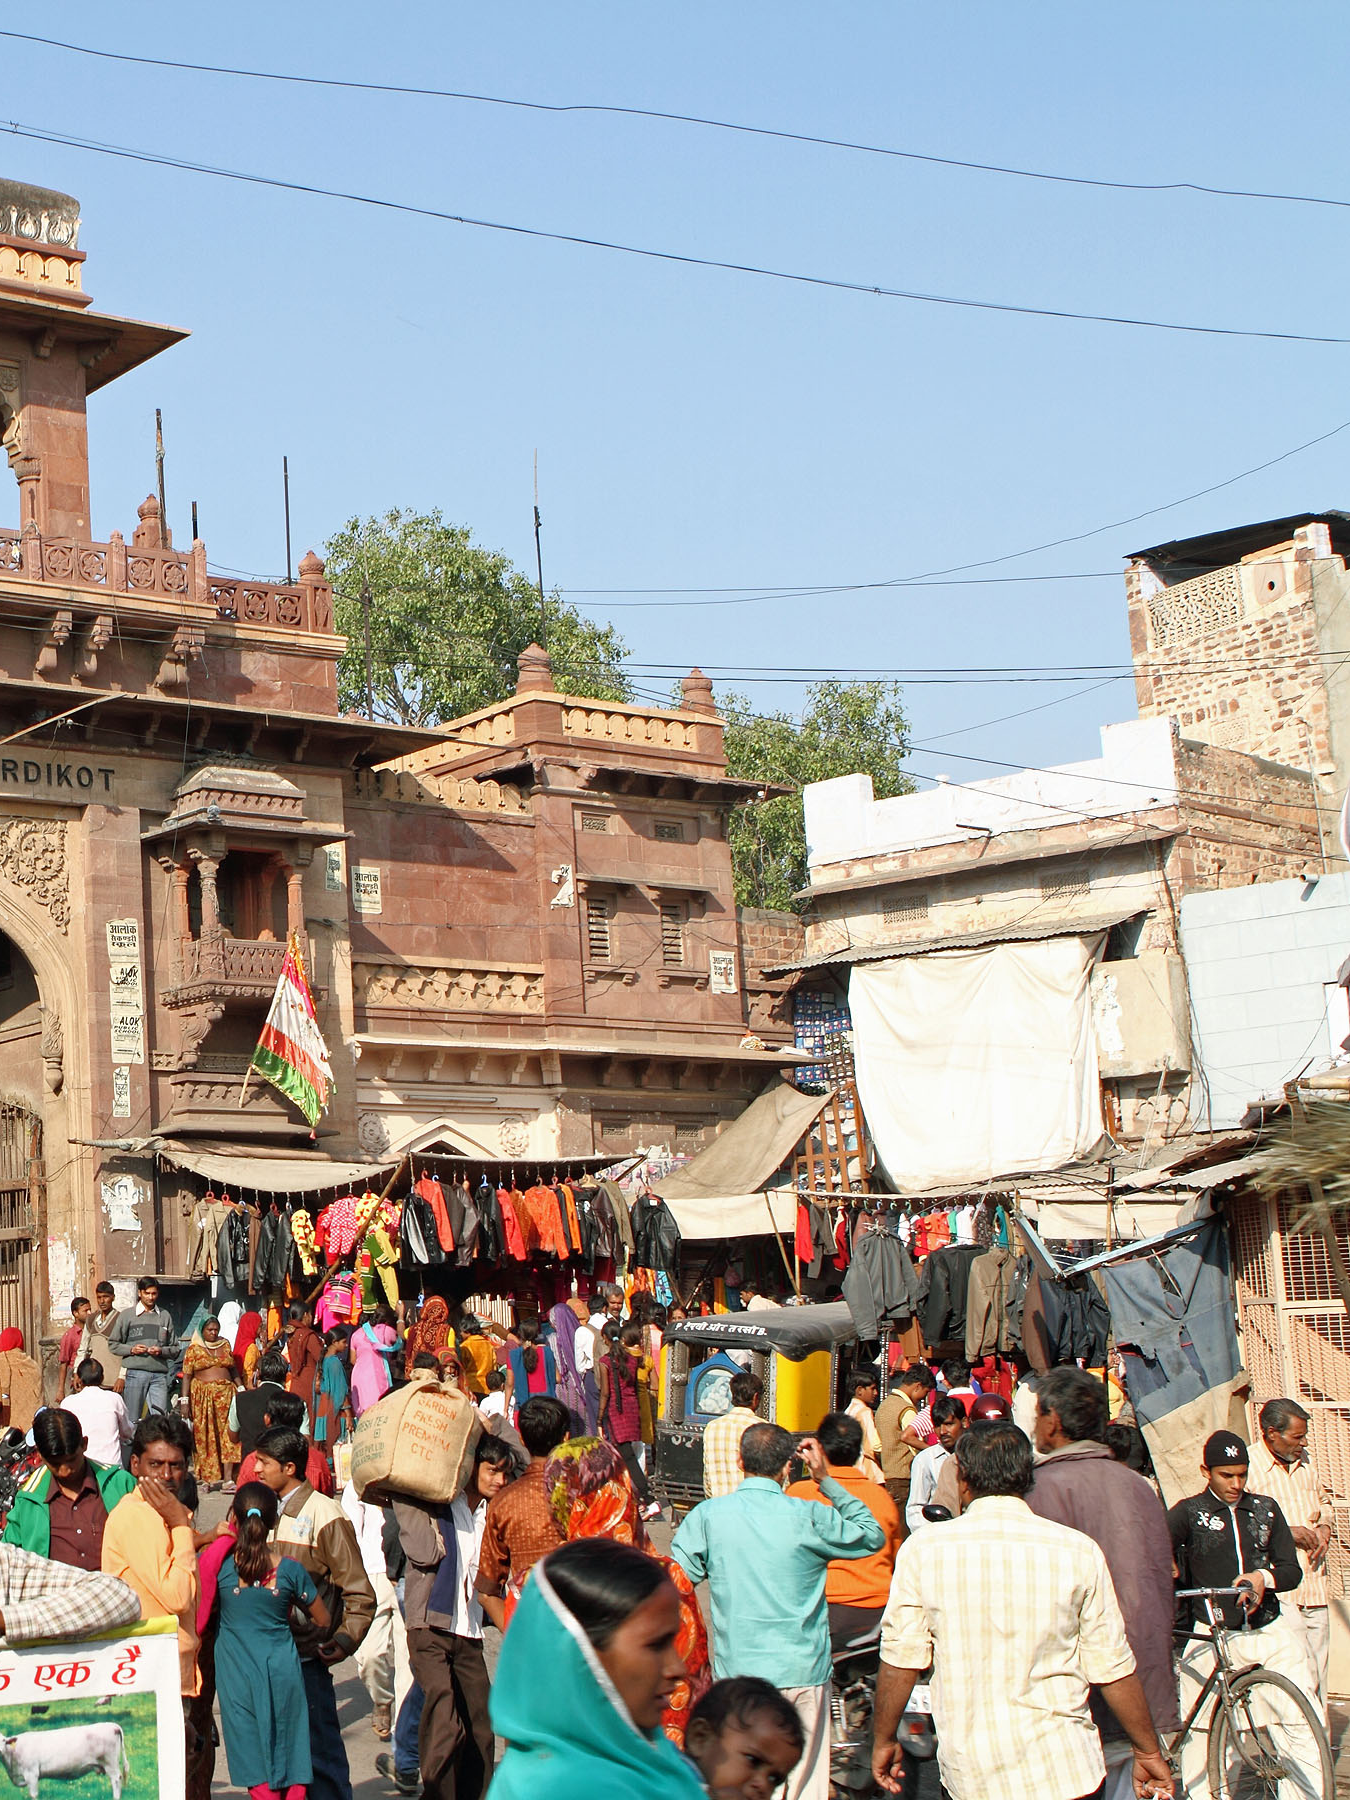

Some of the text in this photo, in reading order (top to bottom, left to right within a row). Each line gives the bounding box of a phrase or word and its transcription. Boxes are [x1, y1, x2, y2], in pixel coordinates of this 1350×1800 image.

[109, 922, 137, 934] आलोक
[120, 967, 139, 979] ALOK
[119, 1016, 140, 1026] ALOK
[418, 1397, 457, 1420] GARDEN
[413, 1410, 449, 1433] FRESH
[402, 1421, 452, 1453] PREMIUM
[410, 1442, 434, 1462] CTC
[33, 1658, 96, 1692] एक
[110, 1645, 143, 1686] है
